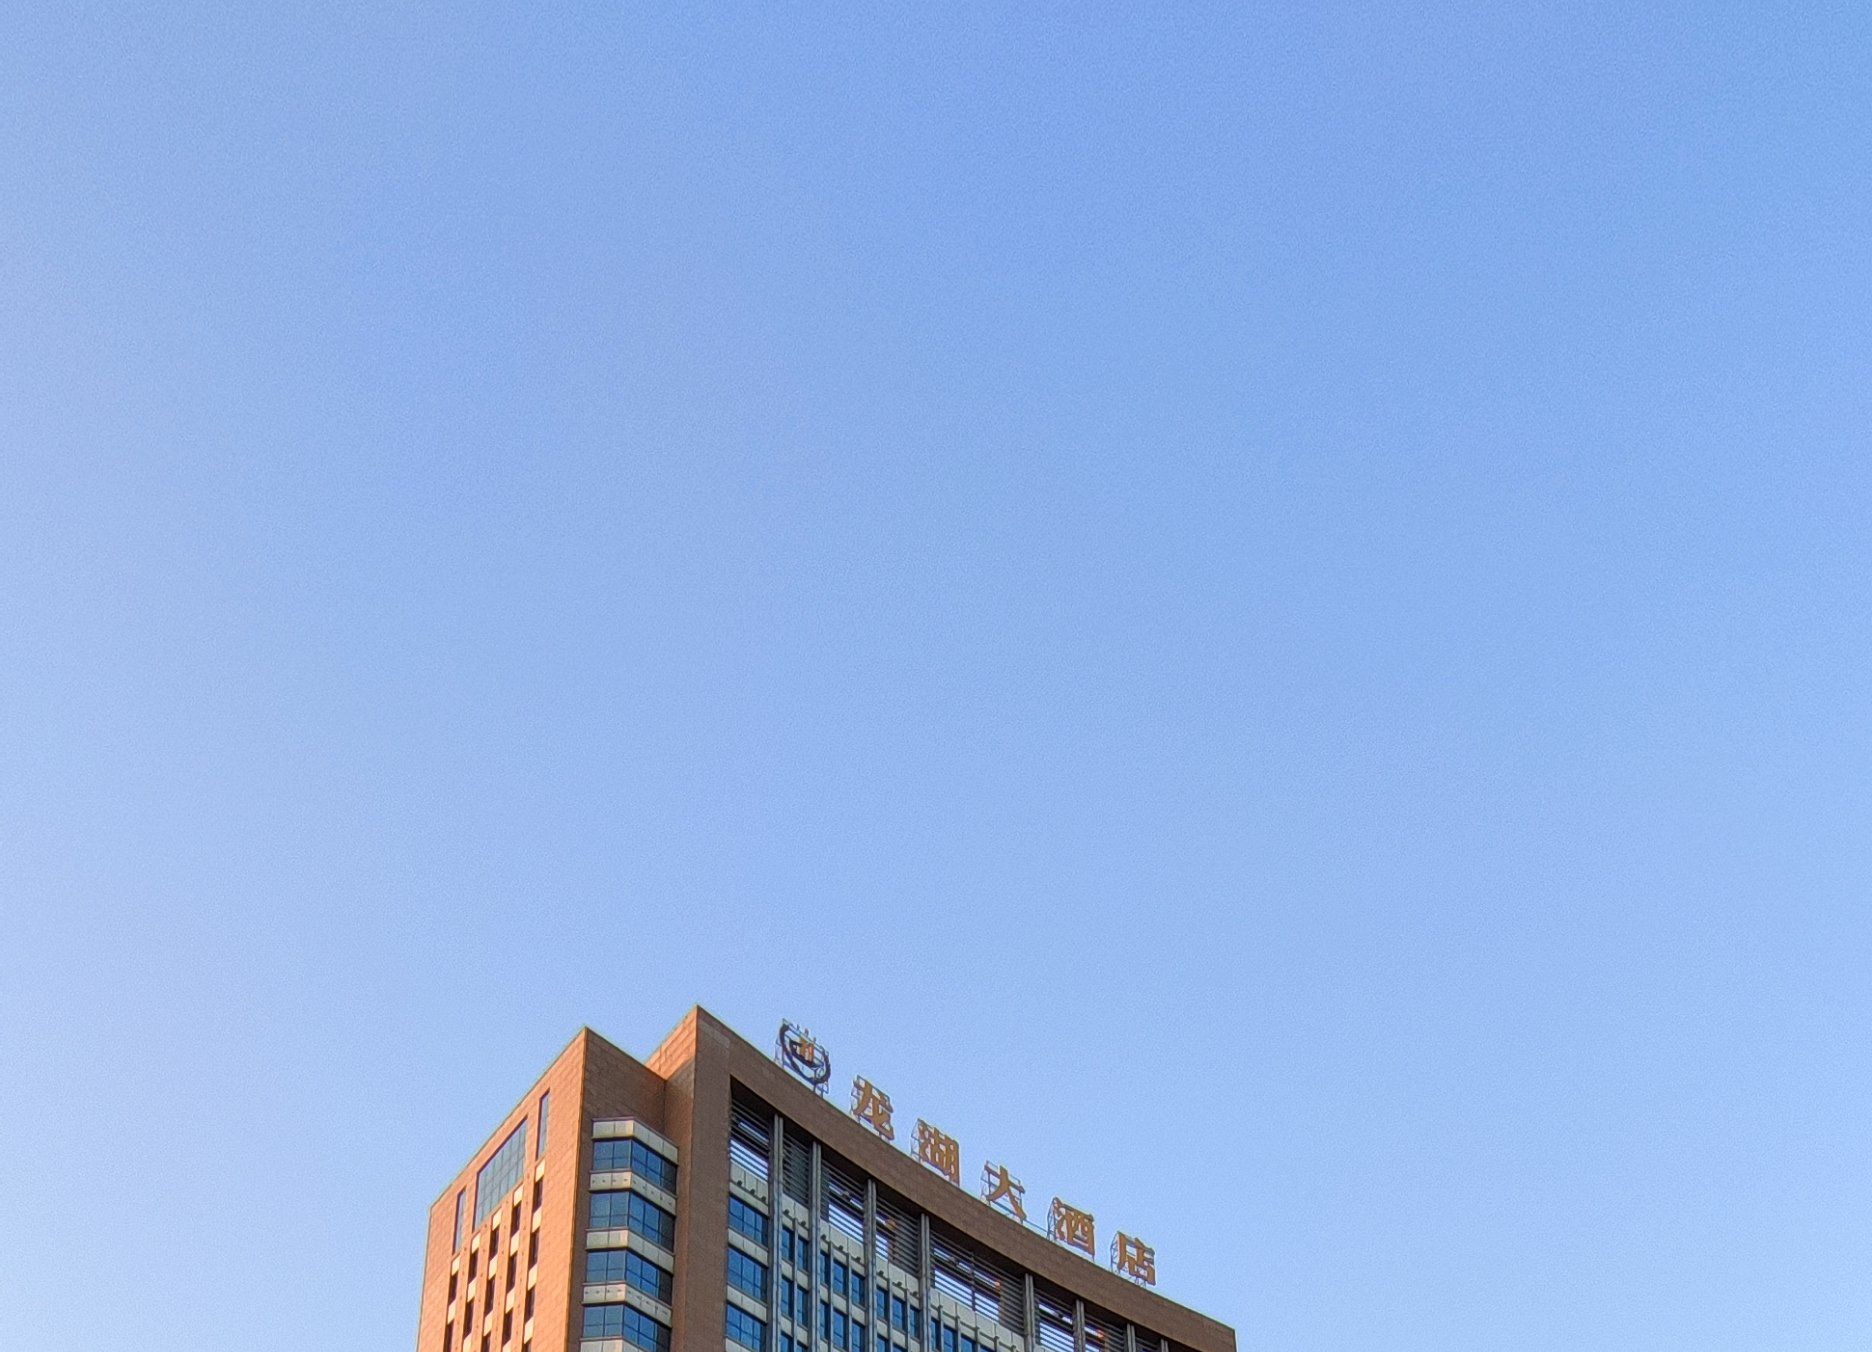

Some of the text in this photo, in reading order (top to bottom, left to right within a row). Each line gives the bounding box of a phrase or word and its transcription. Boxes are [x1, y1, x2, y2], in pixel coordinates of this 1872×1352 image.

[852, 1078, 1156, 1286] 龙湖大酒店
